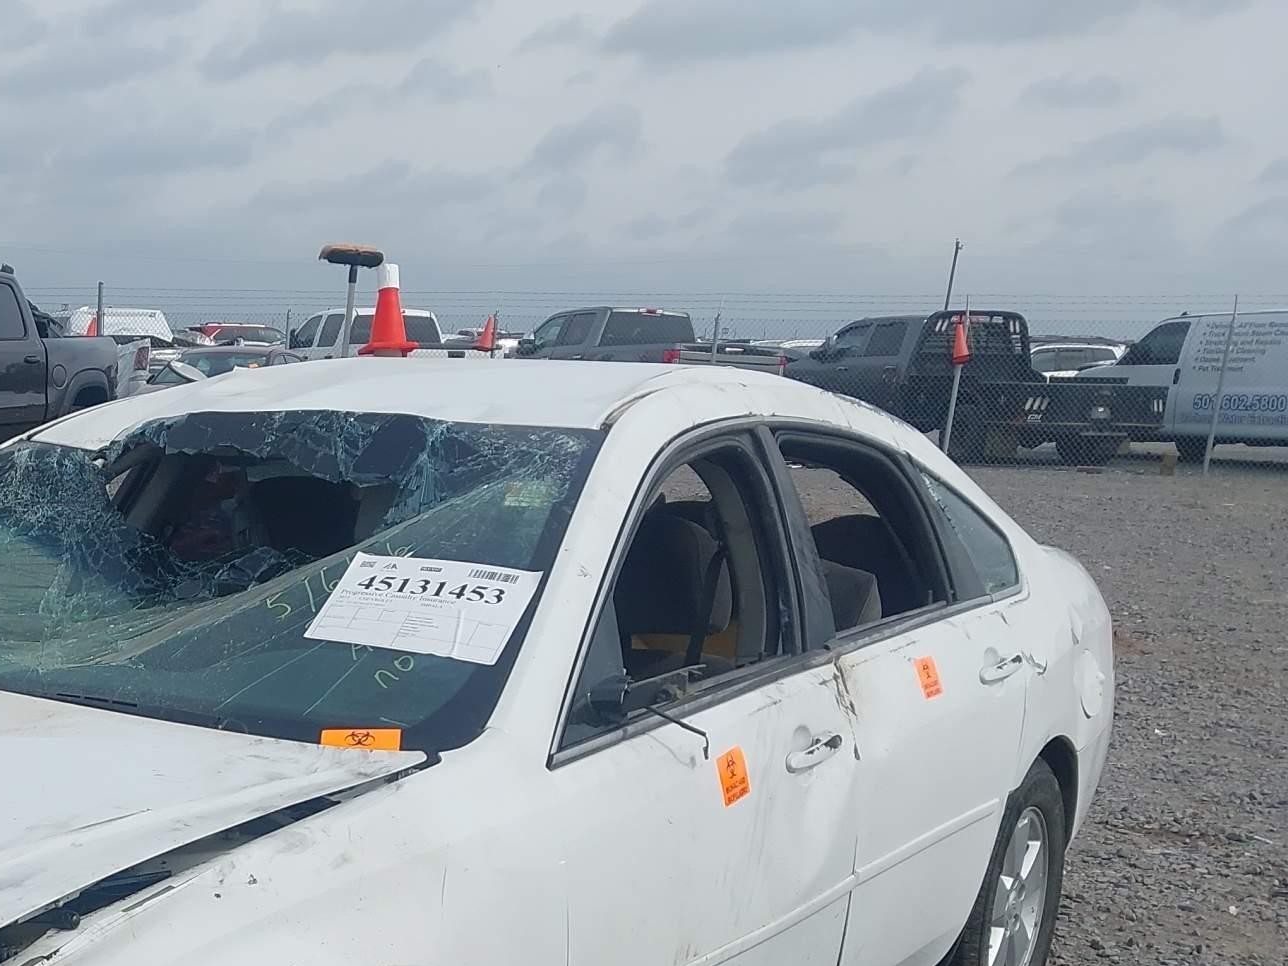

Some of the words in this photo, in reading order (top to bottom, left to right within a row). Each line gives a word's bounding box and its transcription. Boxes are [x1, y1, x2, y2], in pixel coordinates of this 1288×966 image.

[340, 589, 384, 597] Progressive
[385, 592, 417, 600] Casualty
[419, 596, 457, 604] Insurance
[357, 575, 506, 605] 45131453
